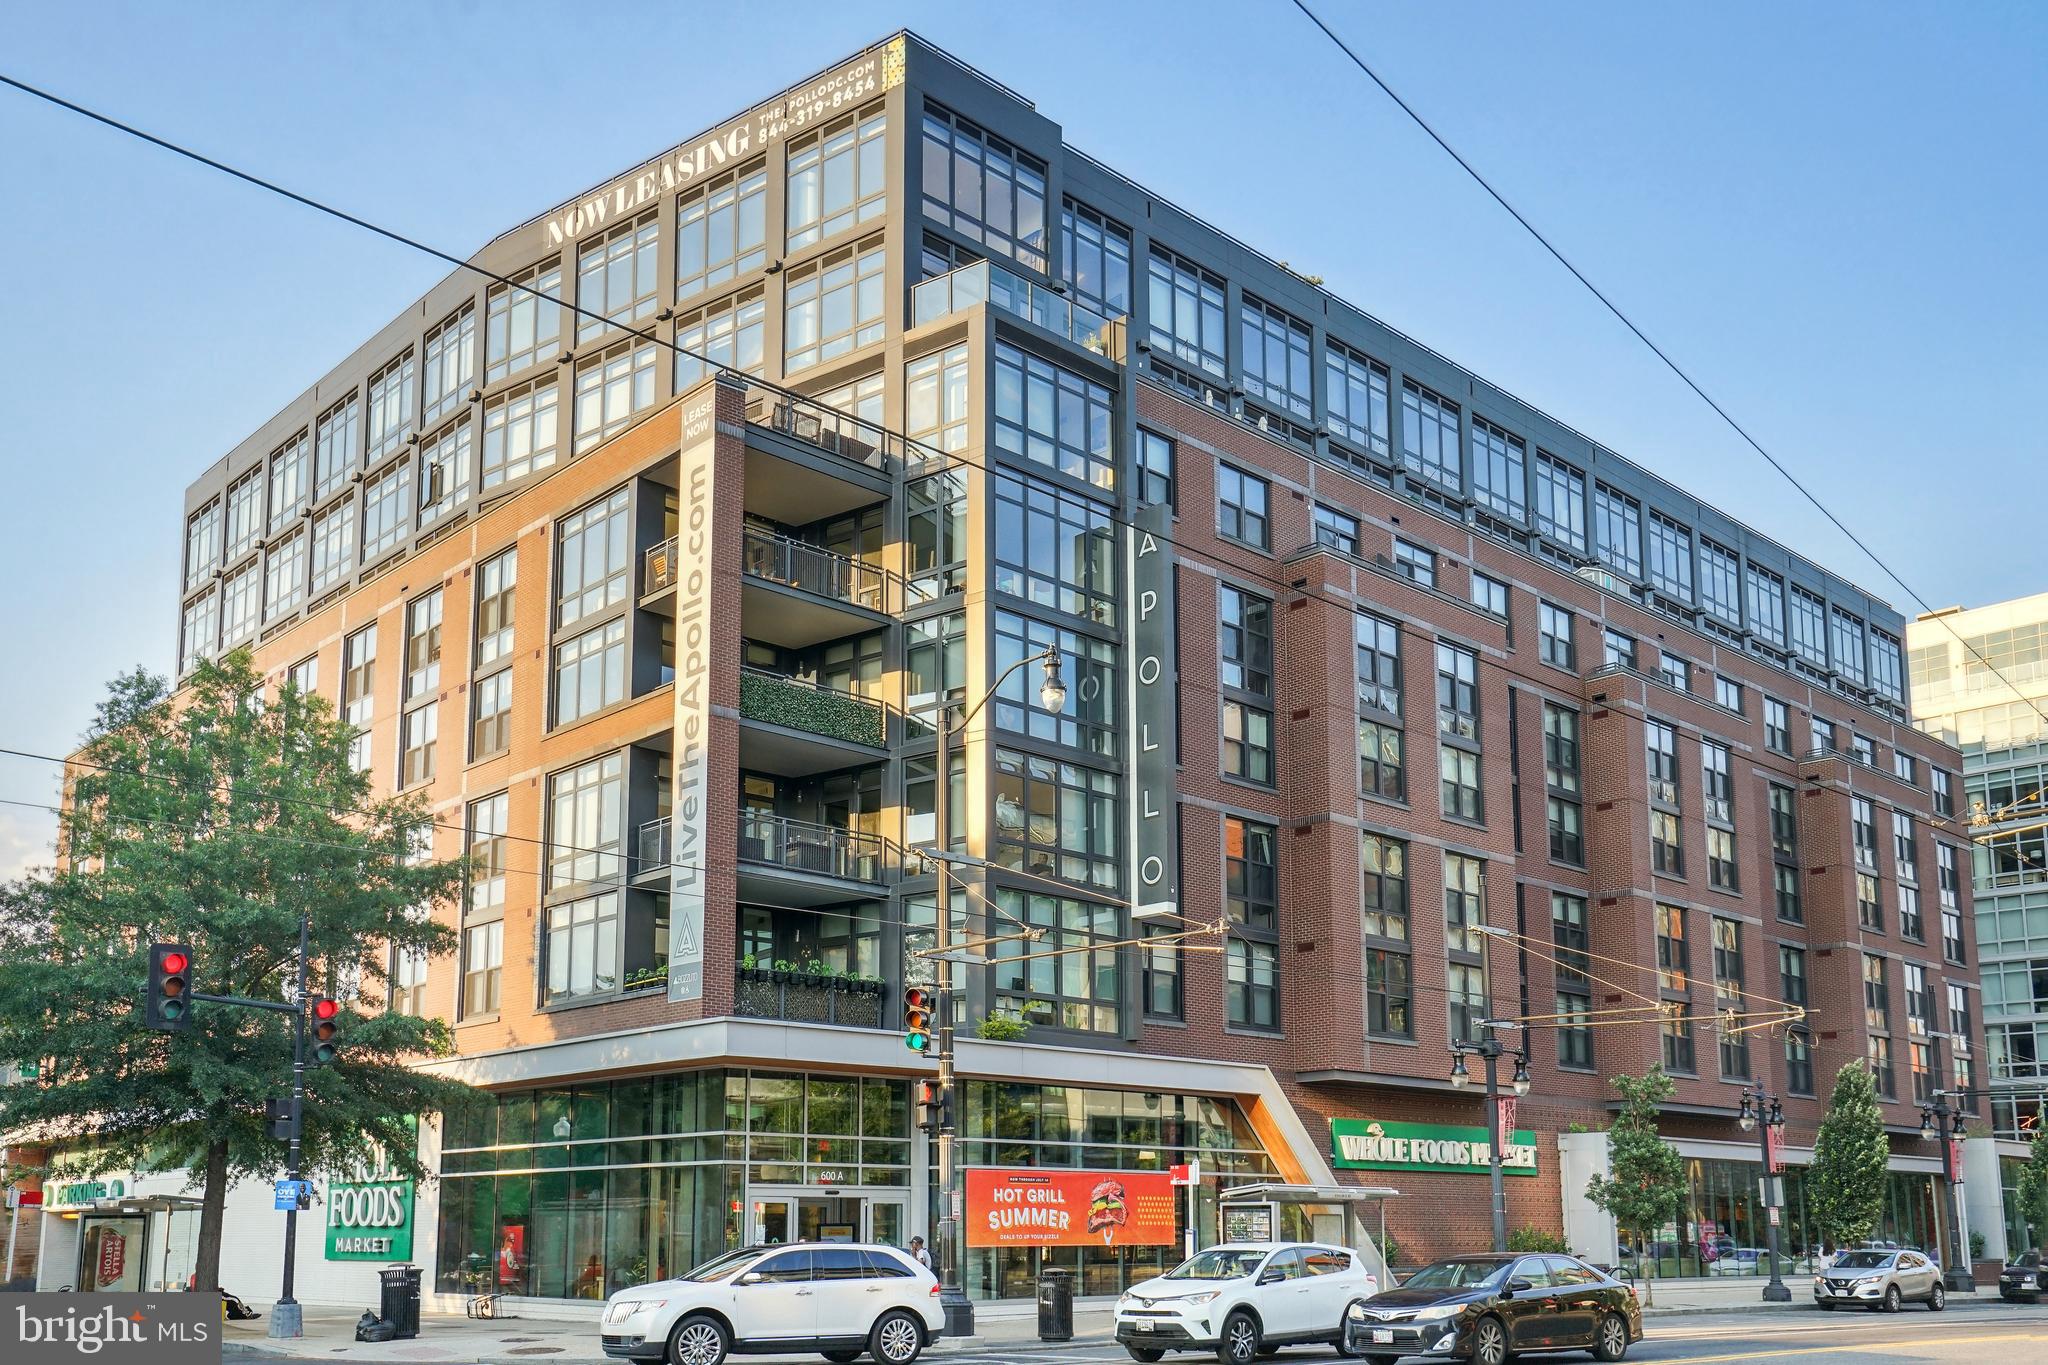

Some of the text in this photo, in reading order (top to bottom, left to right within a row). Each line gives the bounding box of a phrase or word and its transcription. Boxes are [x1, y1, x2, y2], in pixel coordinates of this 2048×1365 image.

[758, 75, 876, 144] 844-319-8454
[547, 123, 751, 249] NOW LEASING
[684, 400, 713, 426] LEASE
[686, 417, 709, 441] NOW
[676, 463, 707, 888] LiveTheApollo.com
[1138, 529, 1163, 885] APOLLO
[1339, 1135, 1537, 1168] WHOLE FOODS MRKET
[820, 1171, 844, 1181] 600 A
[57, 1181, 107, 1207] PARKING
[328, 1186, 405, 1227] FOODS
[993, 1188, 1066, 1203] HOT GRILL
[988, 1207, 1071, 1231] SUMMER
[103, 1240, 114, 1276] ARTOIS
[112, 1240, 122, 1275] STELLA
[335, 1236, 392, 1254] MARKET
